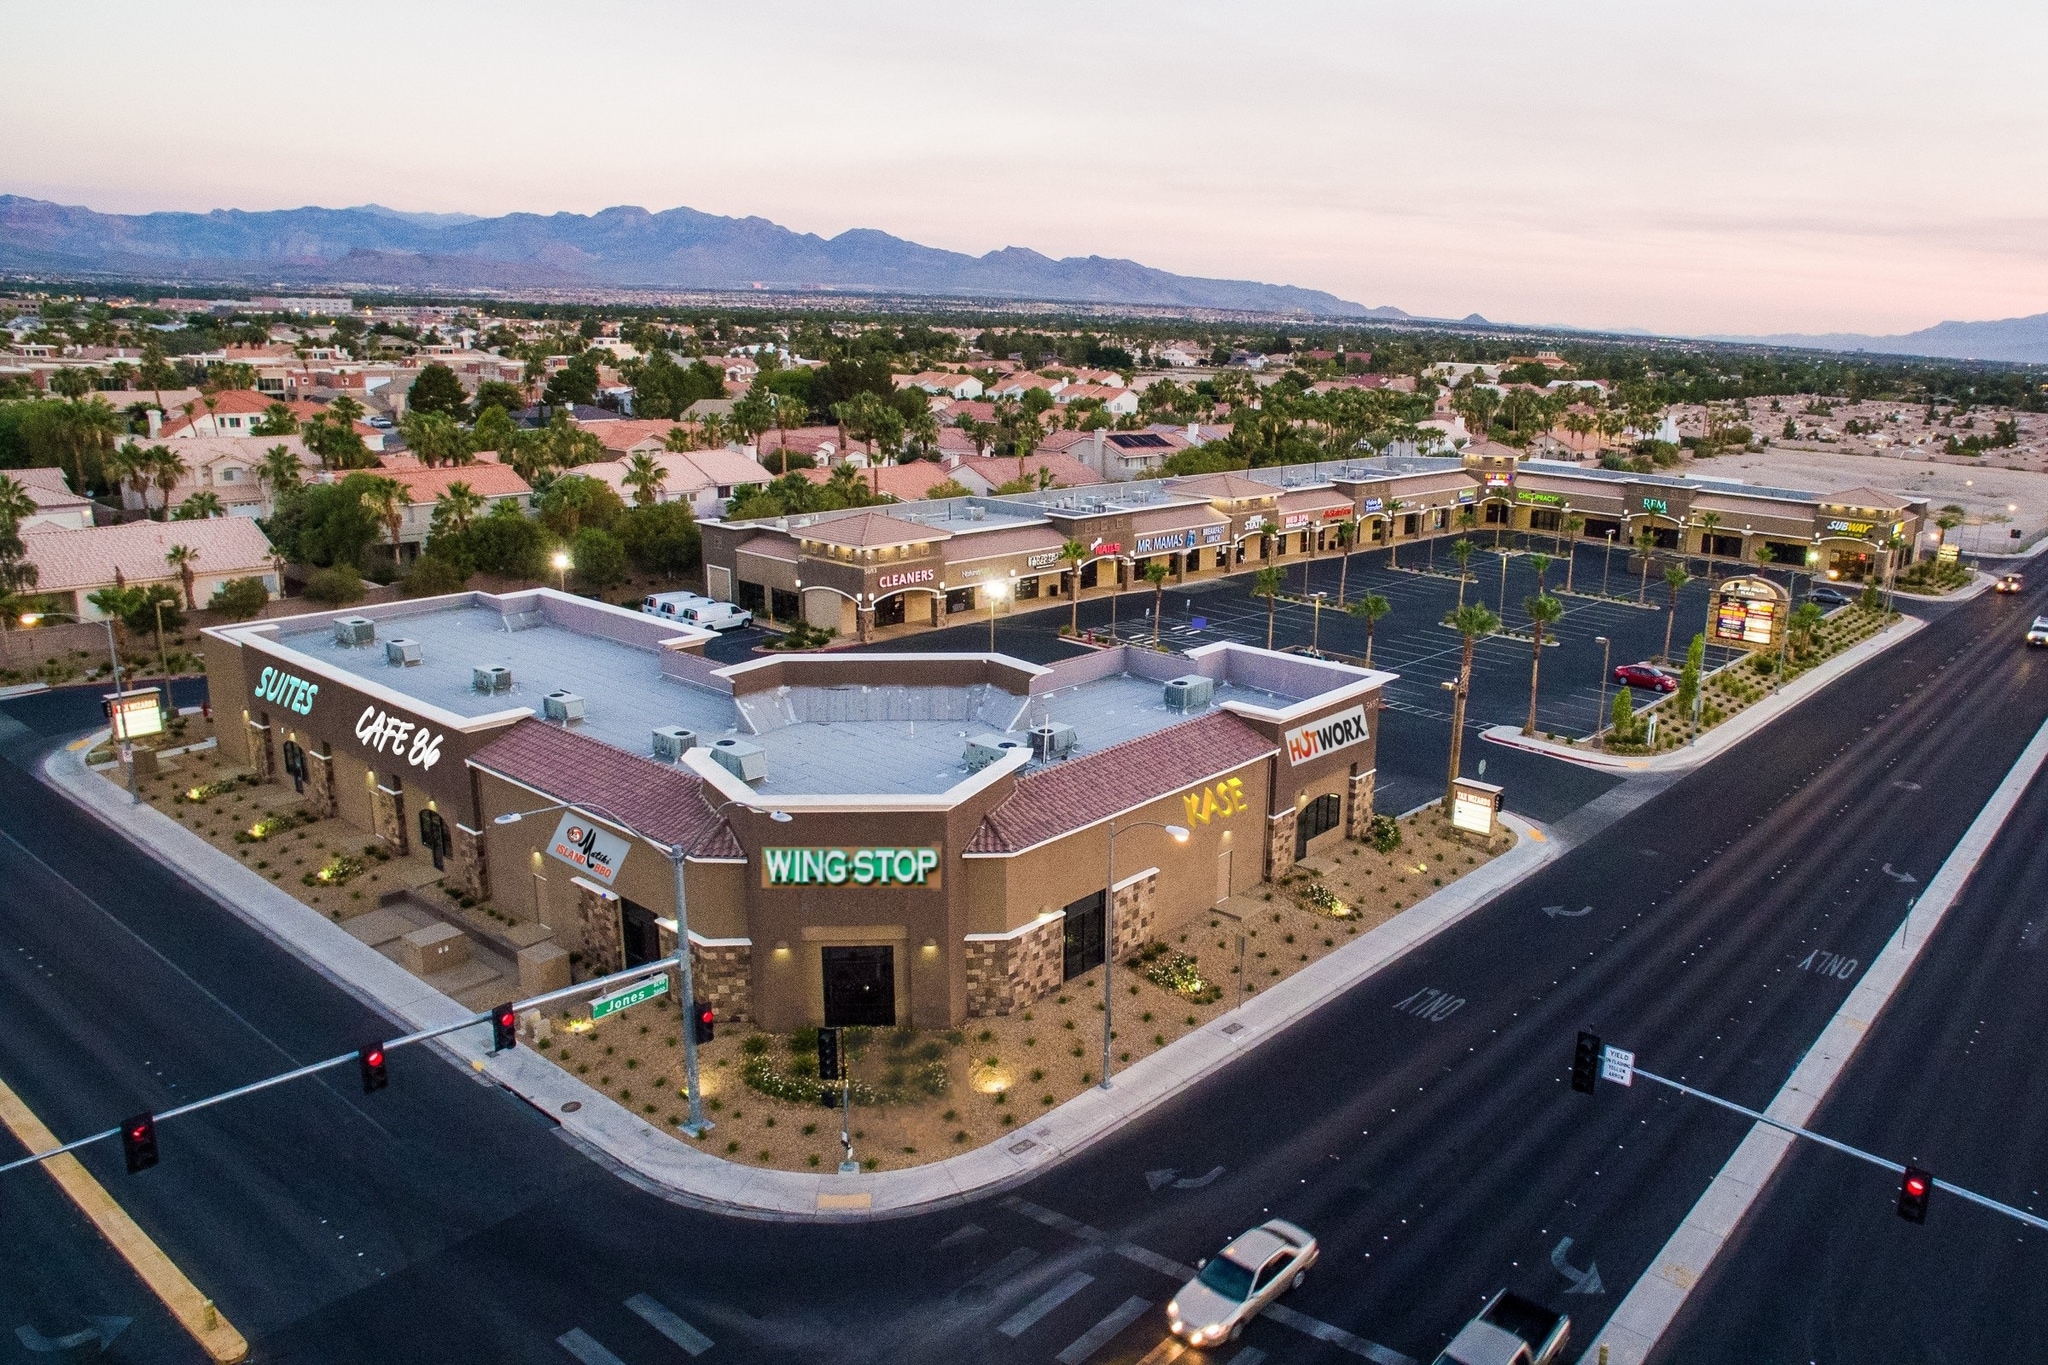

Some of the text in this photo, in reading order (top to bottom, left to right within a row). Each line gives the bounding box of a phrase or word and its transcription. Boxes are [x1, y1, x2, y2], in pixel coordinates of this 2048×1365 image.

[1827, 521, 1874, 533] SUBWAY
[1137, 534, 1183, 553] MR. MAMAS
[879, 568, 934, 588] CLEANERS
[254, 667, 319, 716] SUITES
[356, 705, 444, 772] CAFE 86
[1288, 714, 1366, 762] HOTWORX
[1183, 777, 1248, 829] KASE
[555, 842, 587, 866] ISLAND
[1797, 949, 1859, 980] ONLY
[606, 990, 645, 1013] Jones
[1609, 1050, 1629, 1061] YIELD
